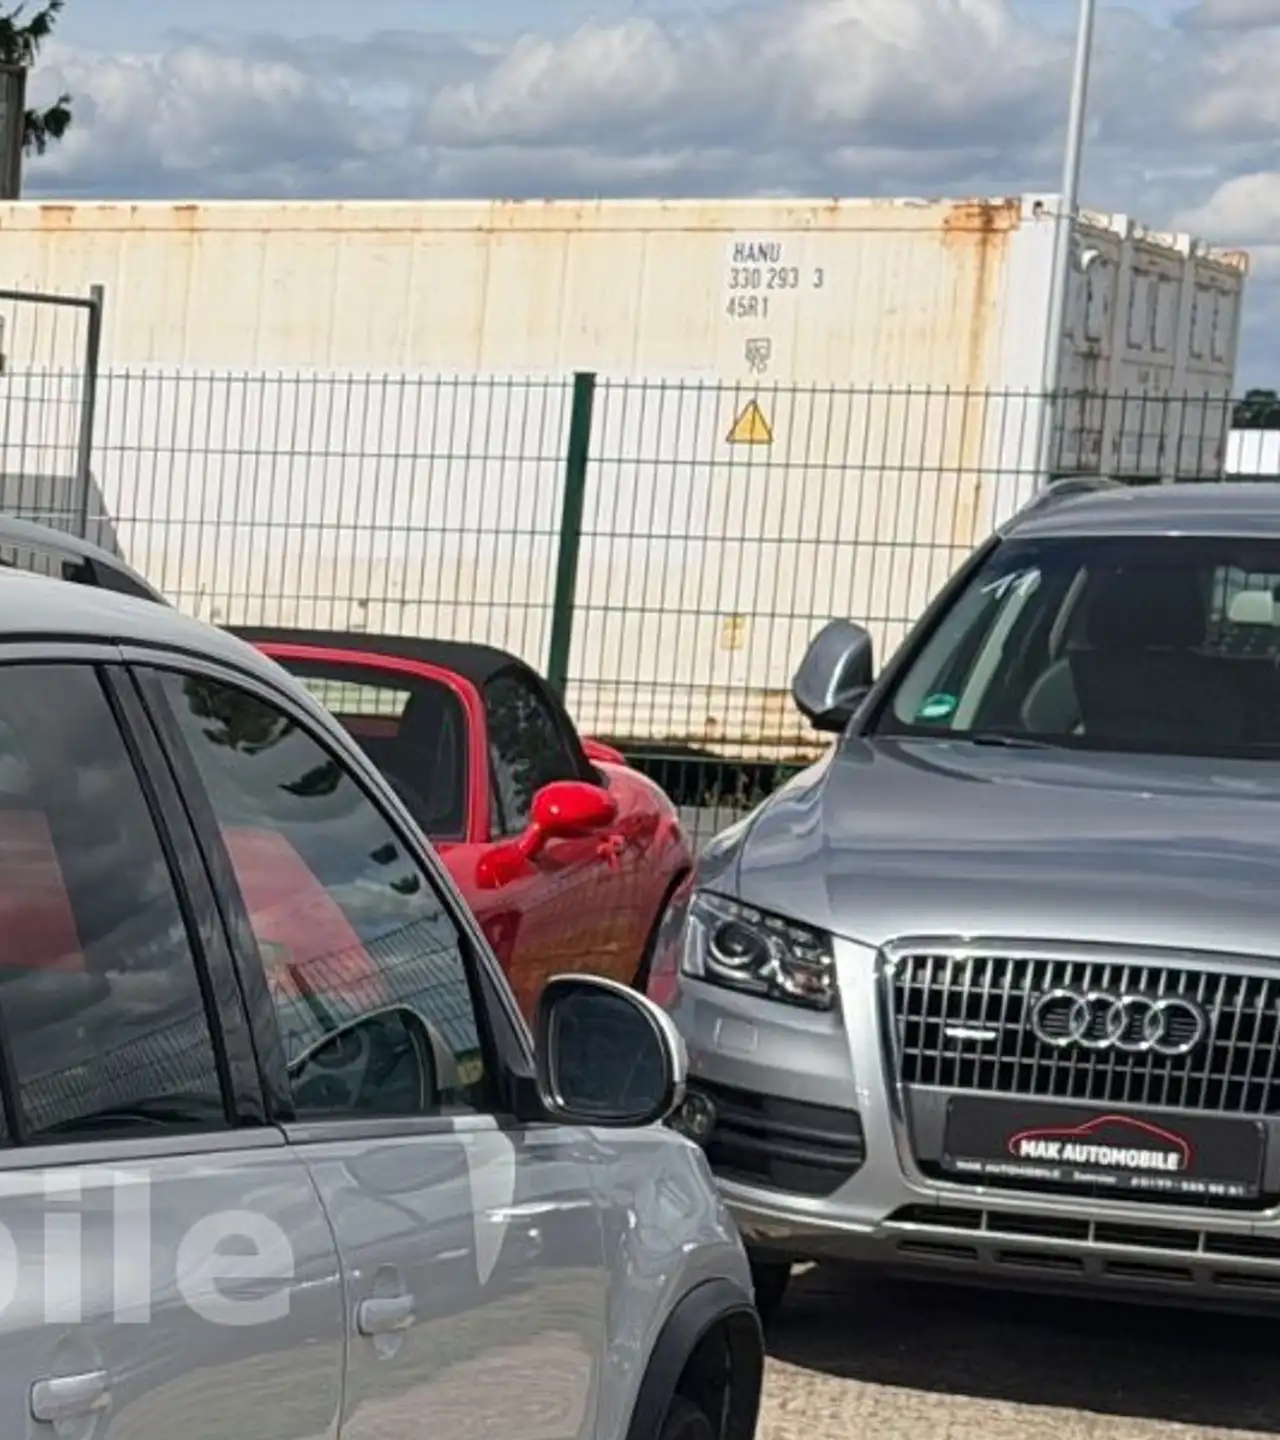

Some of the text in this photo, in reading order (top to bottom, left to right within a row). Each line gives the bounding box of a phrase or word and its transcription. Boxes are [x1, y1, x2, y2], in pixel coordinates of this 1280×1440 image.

[732, 241, 782, 263] HANU
[727, 266, 824, 290] 330 293 3
[1018, 1138, 1181, 1171] MAK AUTOMOBILE
